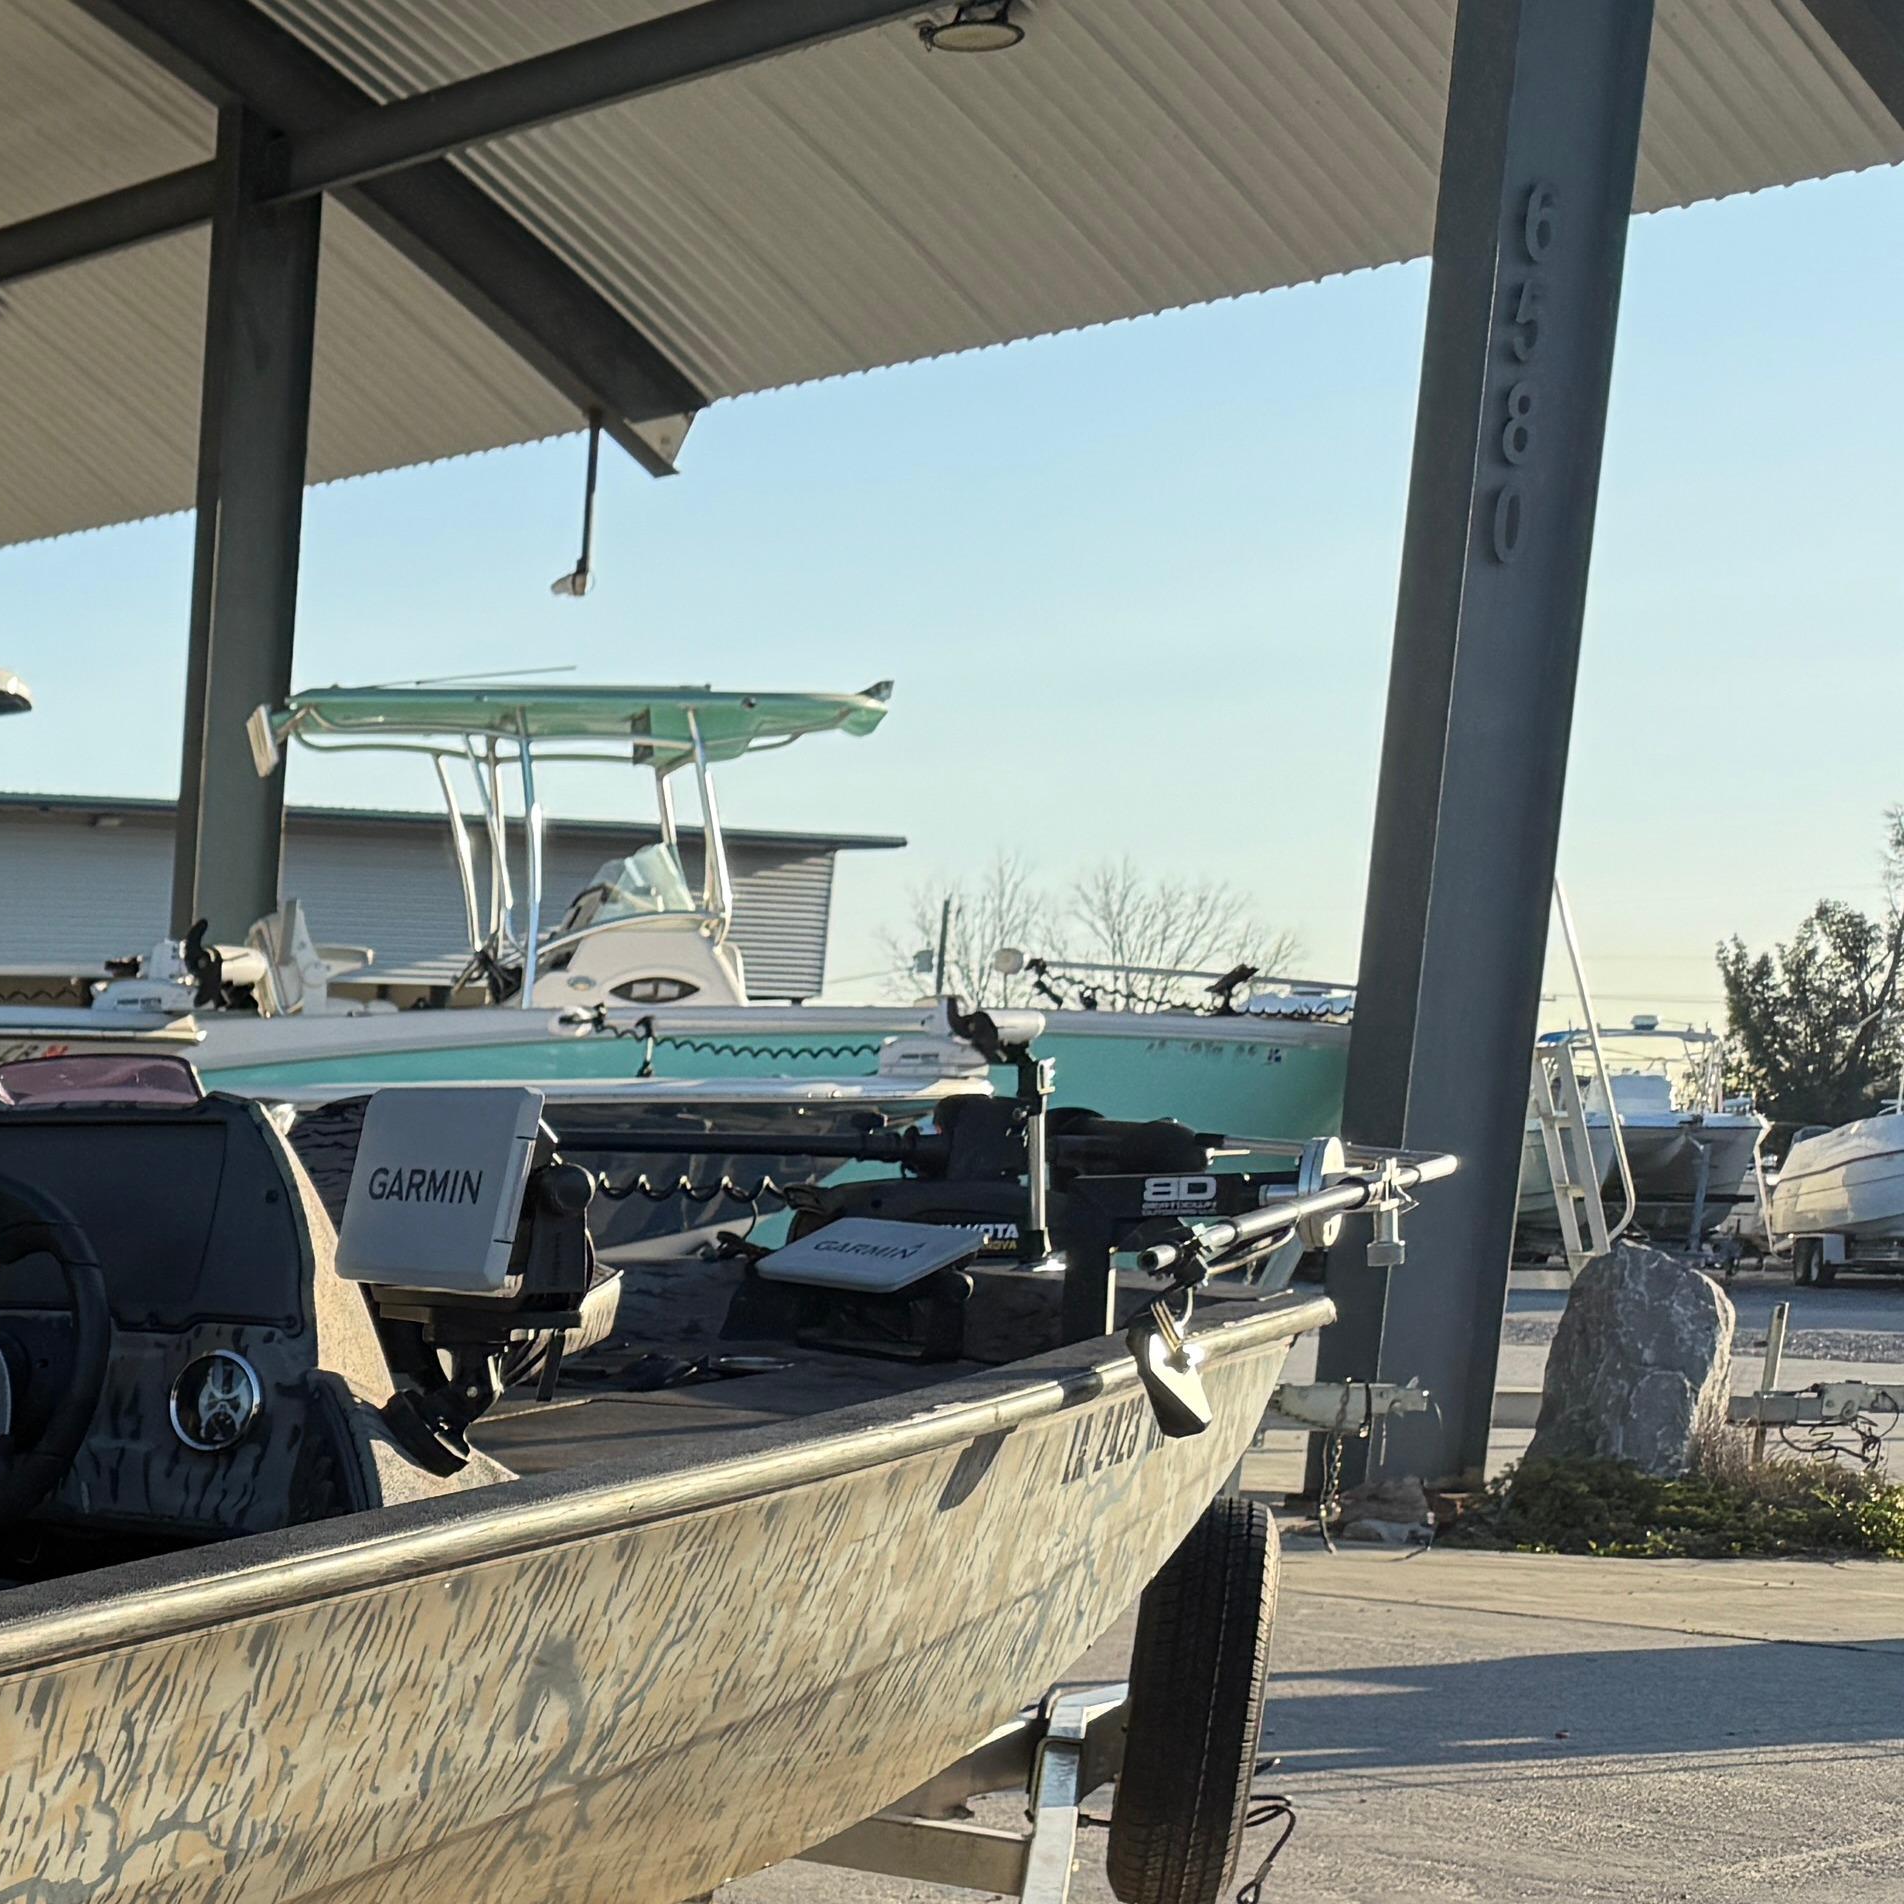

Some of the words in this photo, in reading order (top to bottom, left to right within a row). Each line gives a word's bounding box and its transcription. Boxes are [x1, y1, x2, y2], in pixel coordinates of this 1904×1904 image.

[1494, 180, 1558, 564] 6580
[368, 1167, 483, 1205] GARMIN
[813, 1240, 927, 1260] GARMIN
